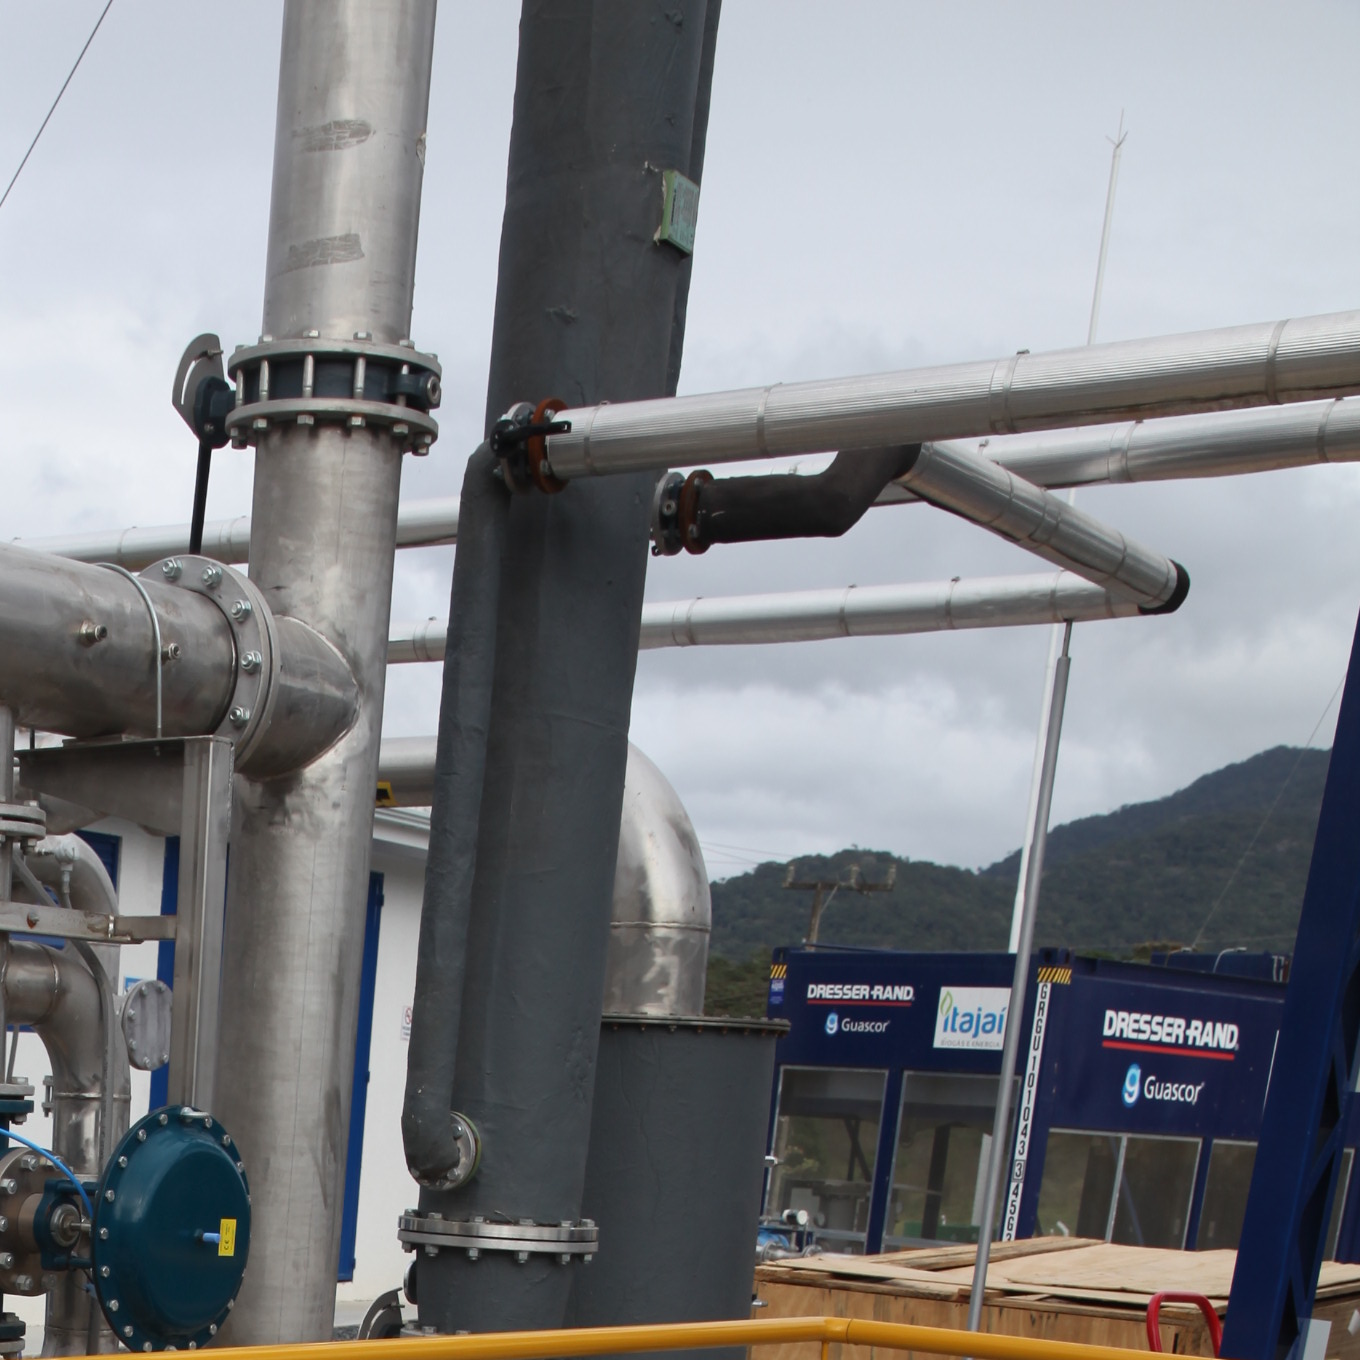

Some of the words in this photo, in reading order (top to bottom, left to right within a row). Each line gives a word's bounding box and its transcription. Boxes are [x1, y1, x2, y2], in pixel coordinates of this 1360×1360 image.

[807, 984, 914, 1000] DRESSER-RAND
[841, 1018, 888, 1033] Guascor
[1102, 1009, 1239, 1050] DRESSER-RAND
[1143, 1075, 1202, 1104] Guascor
